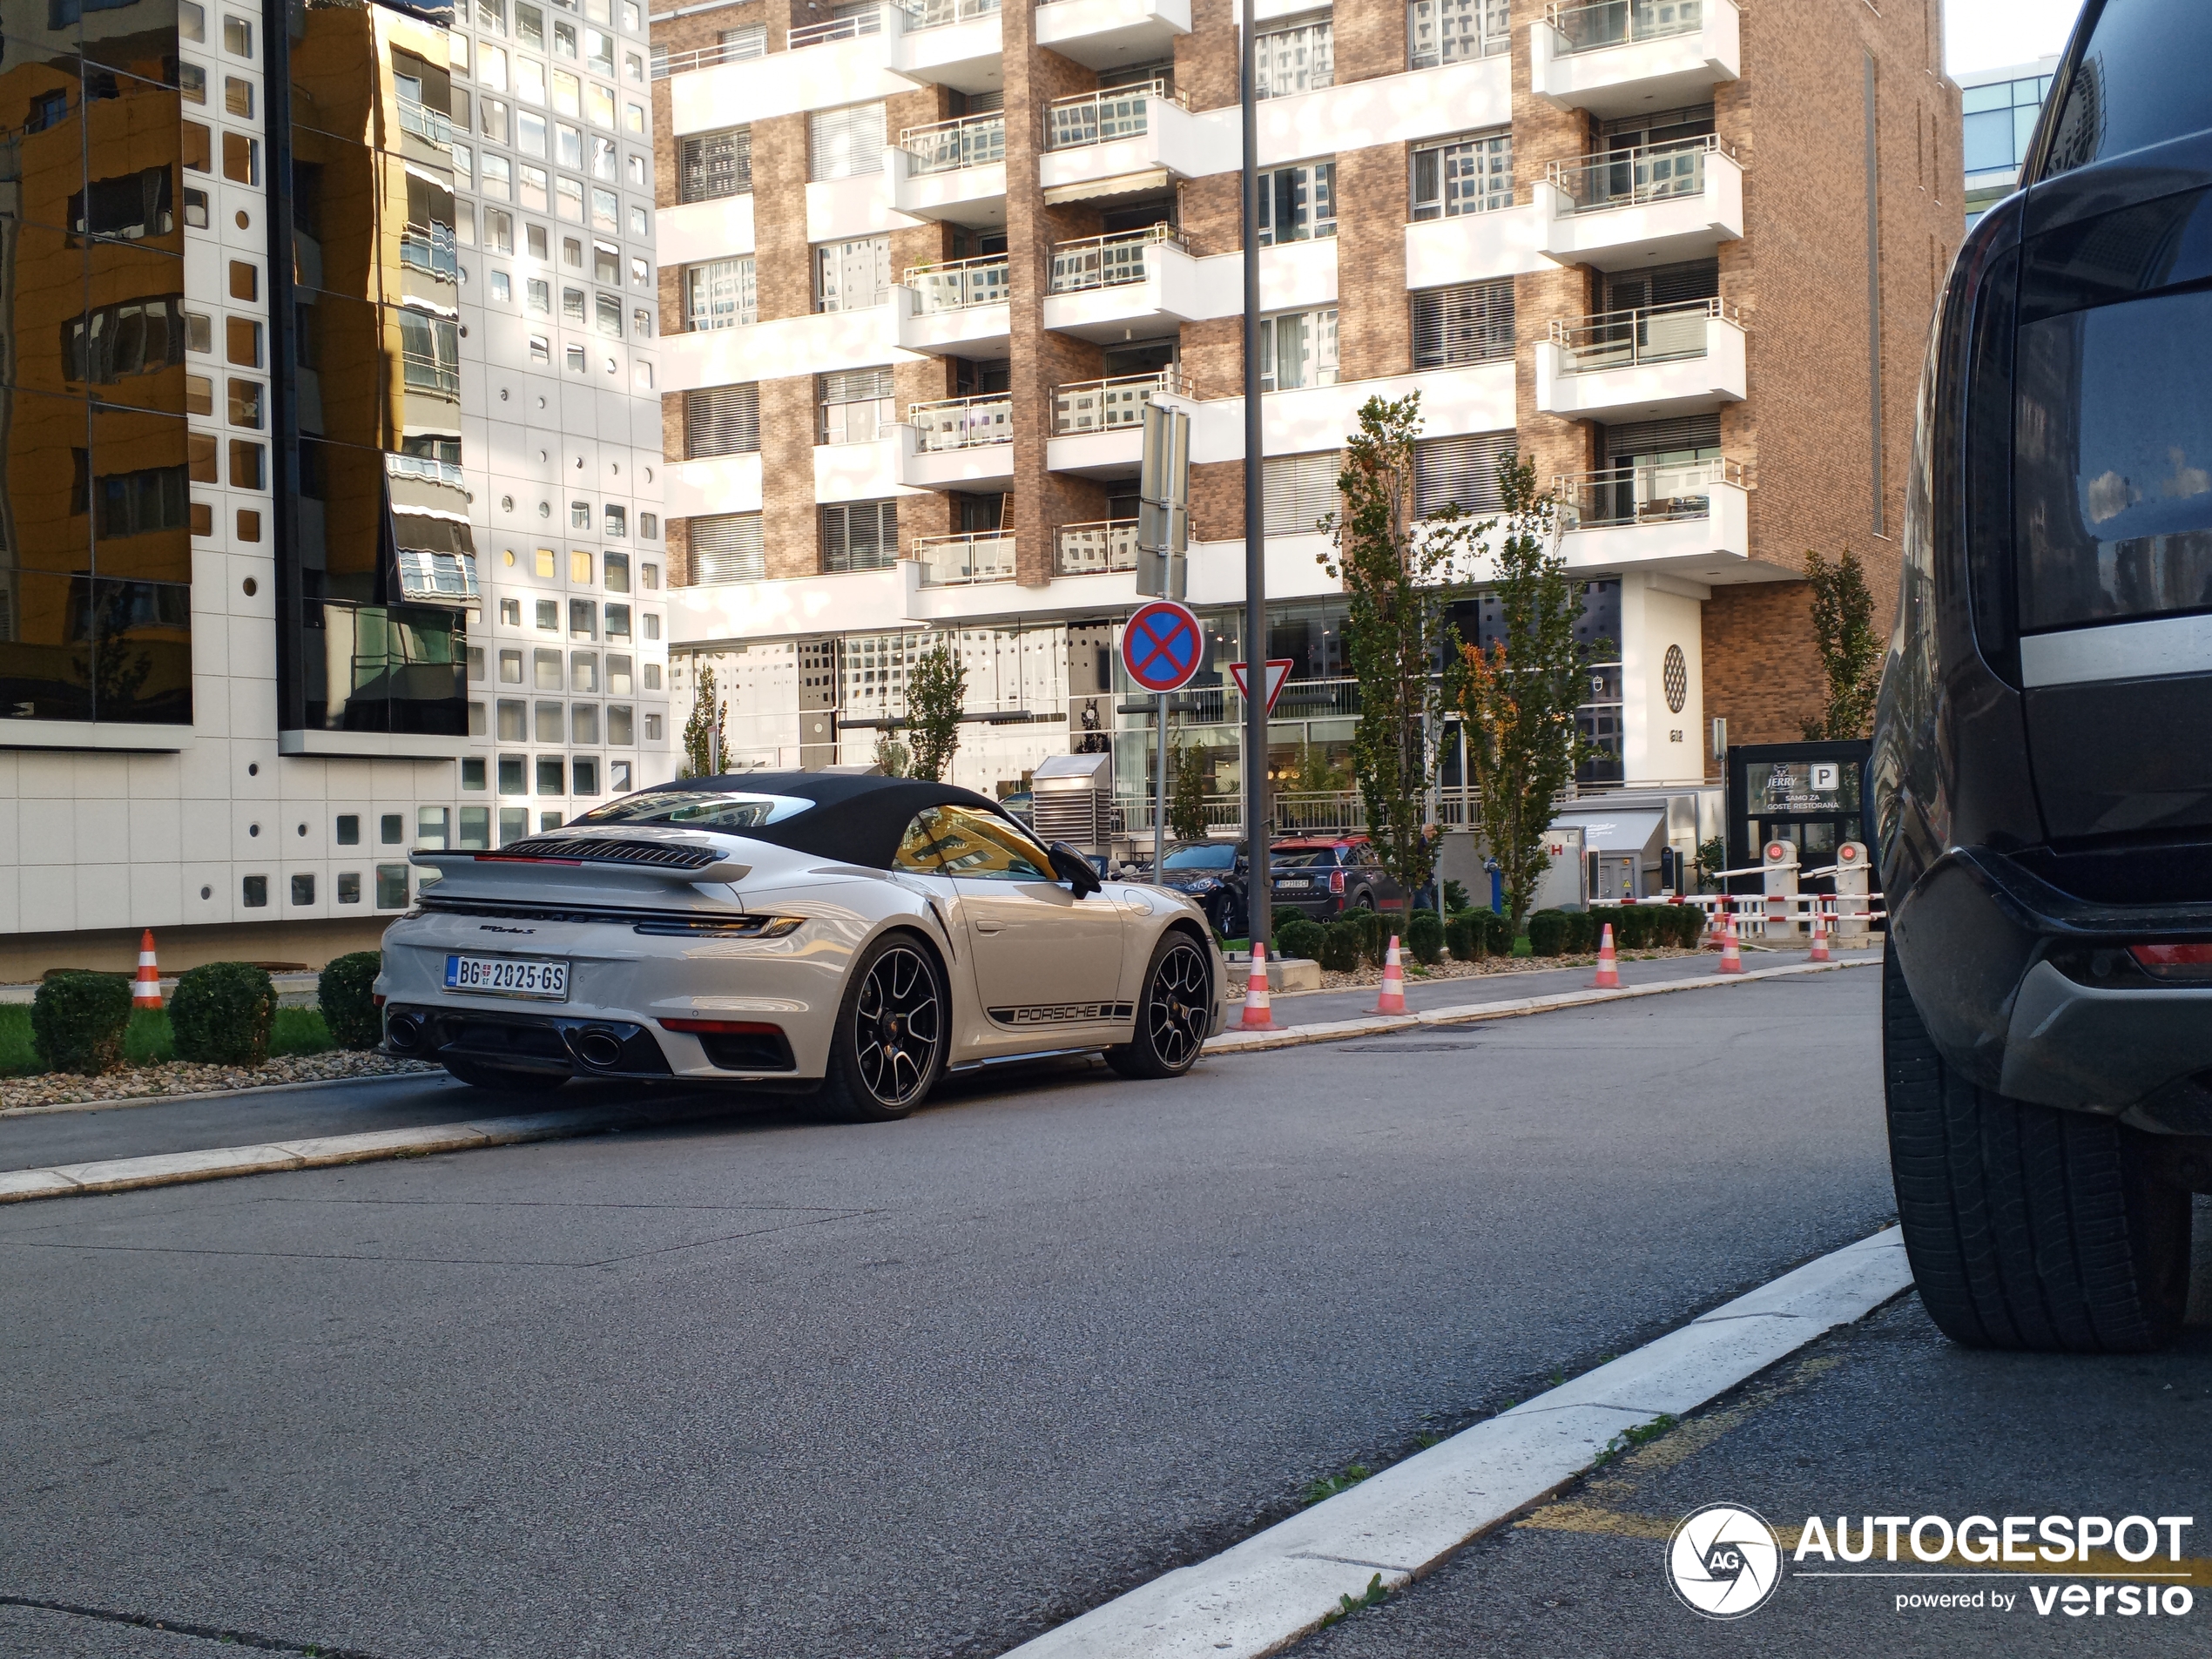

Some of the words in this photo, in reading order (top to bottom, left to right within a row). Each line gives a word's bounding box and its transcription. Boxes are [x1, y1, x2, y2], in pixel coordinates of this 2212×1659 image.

[1766, 777, 1797, 788] JERRY
[1818, 769, 1831, 785] P
[1551, 844, 1563, 855] H
[460, 961, 480, 984] BG
[1017, 1005, 1098, 1022] PORSCHE
